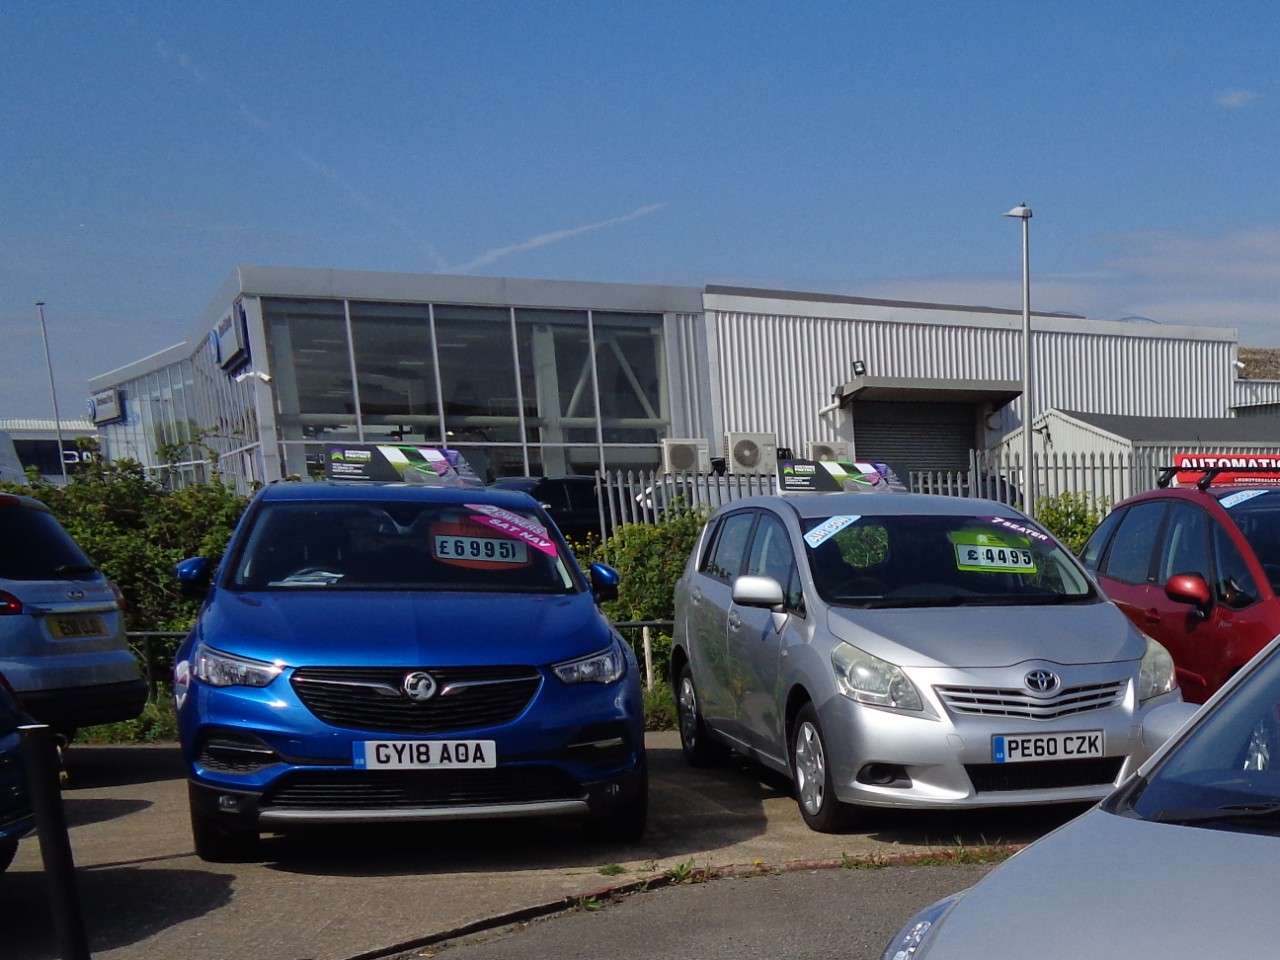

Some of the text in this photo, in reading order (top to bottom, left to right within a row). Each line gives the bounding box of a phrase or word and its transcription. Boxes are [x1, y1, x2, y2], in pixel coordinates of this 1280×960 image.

[489, 519, 551, 547] SAT NAV
[1003, 521, 1048, 541] SEATER
[375, 743, 486, 764] GY18 AOA
[1007, 735, 1099, 758] PE60 CZK
